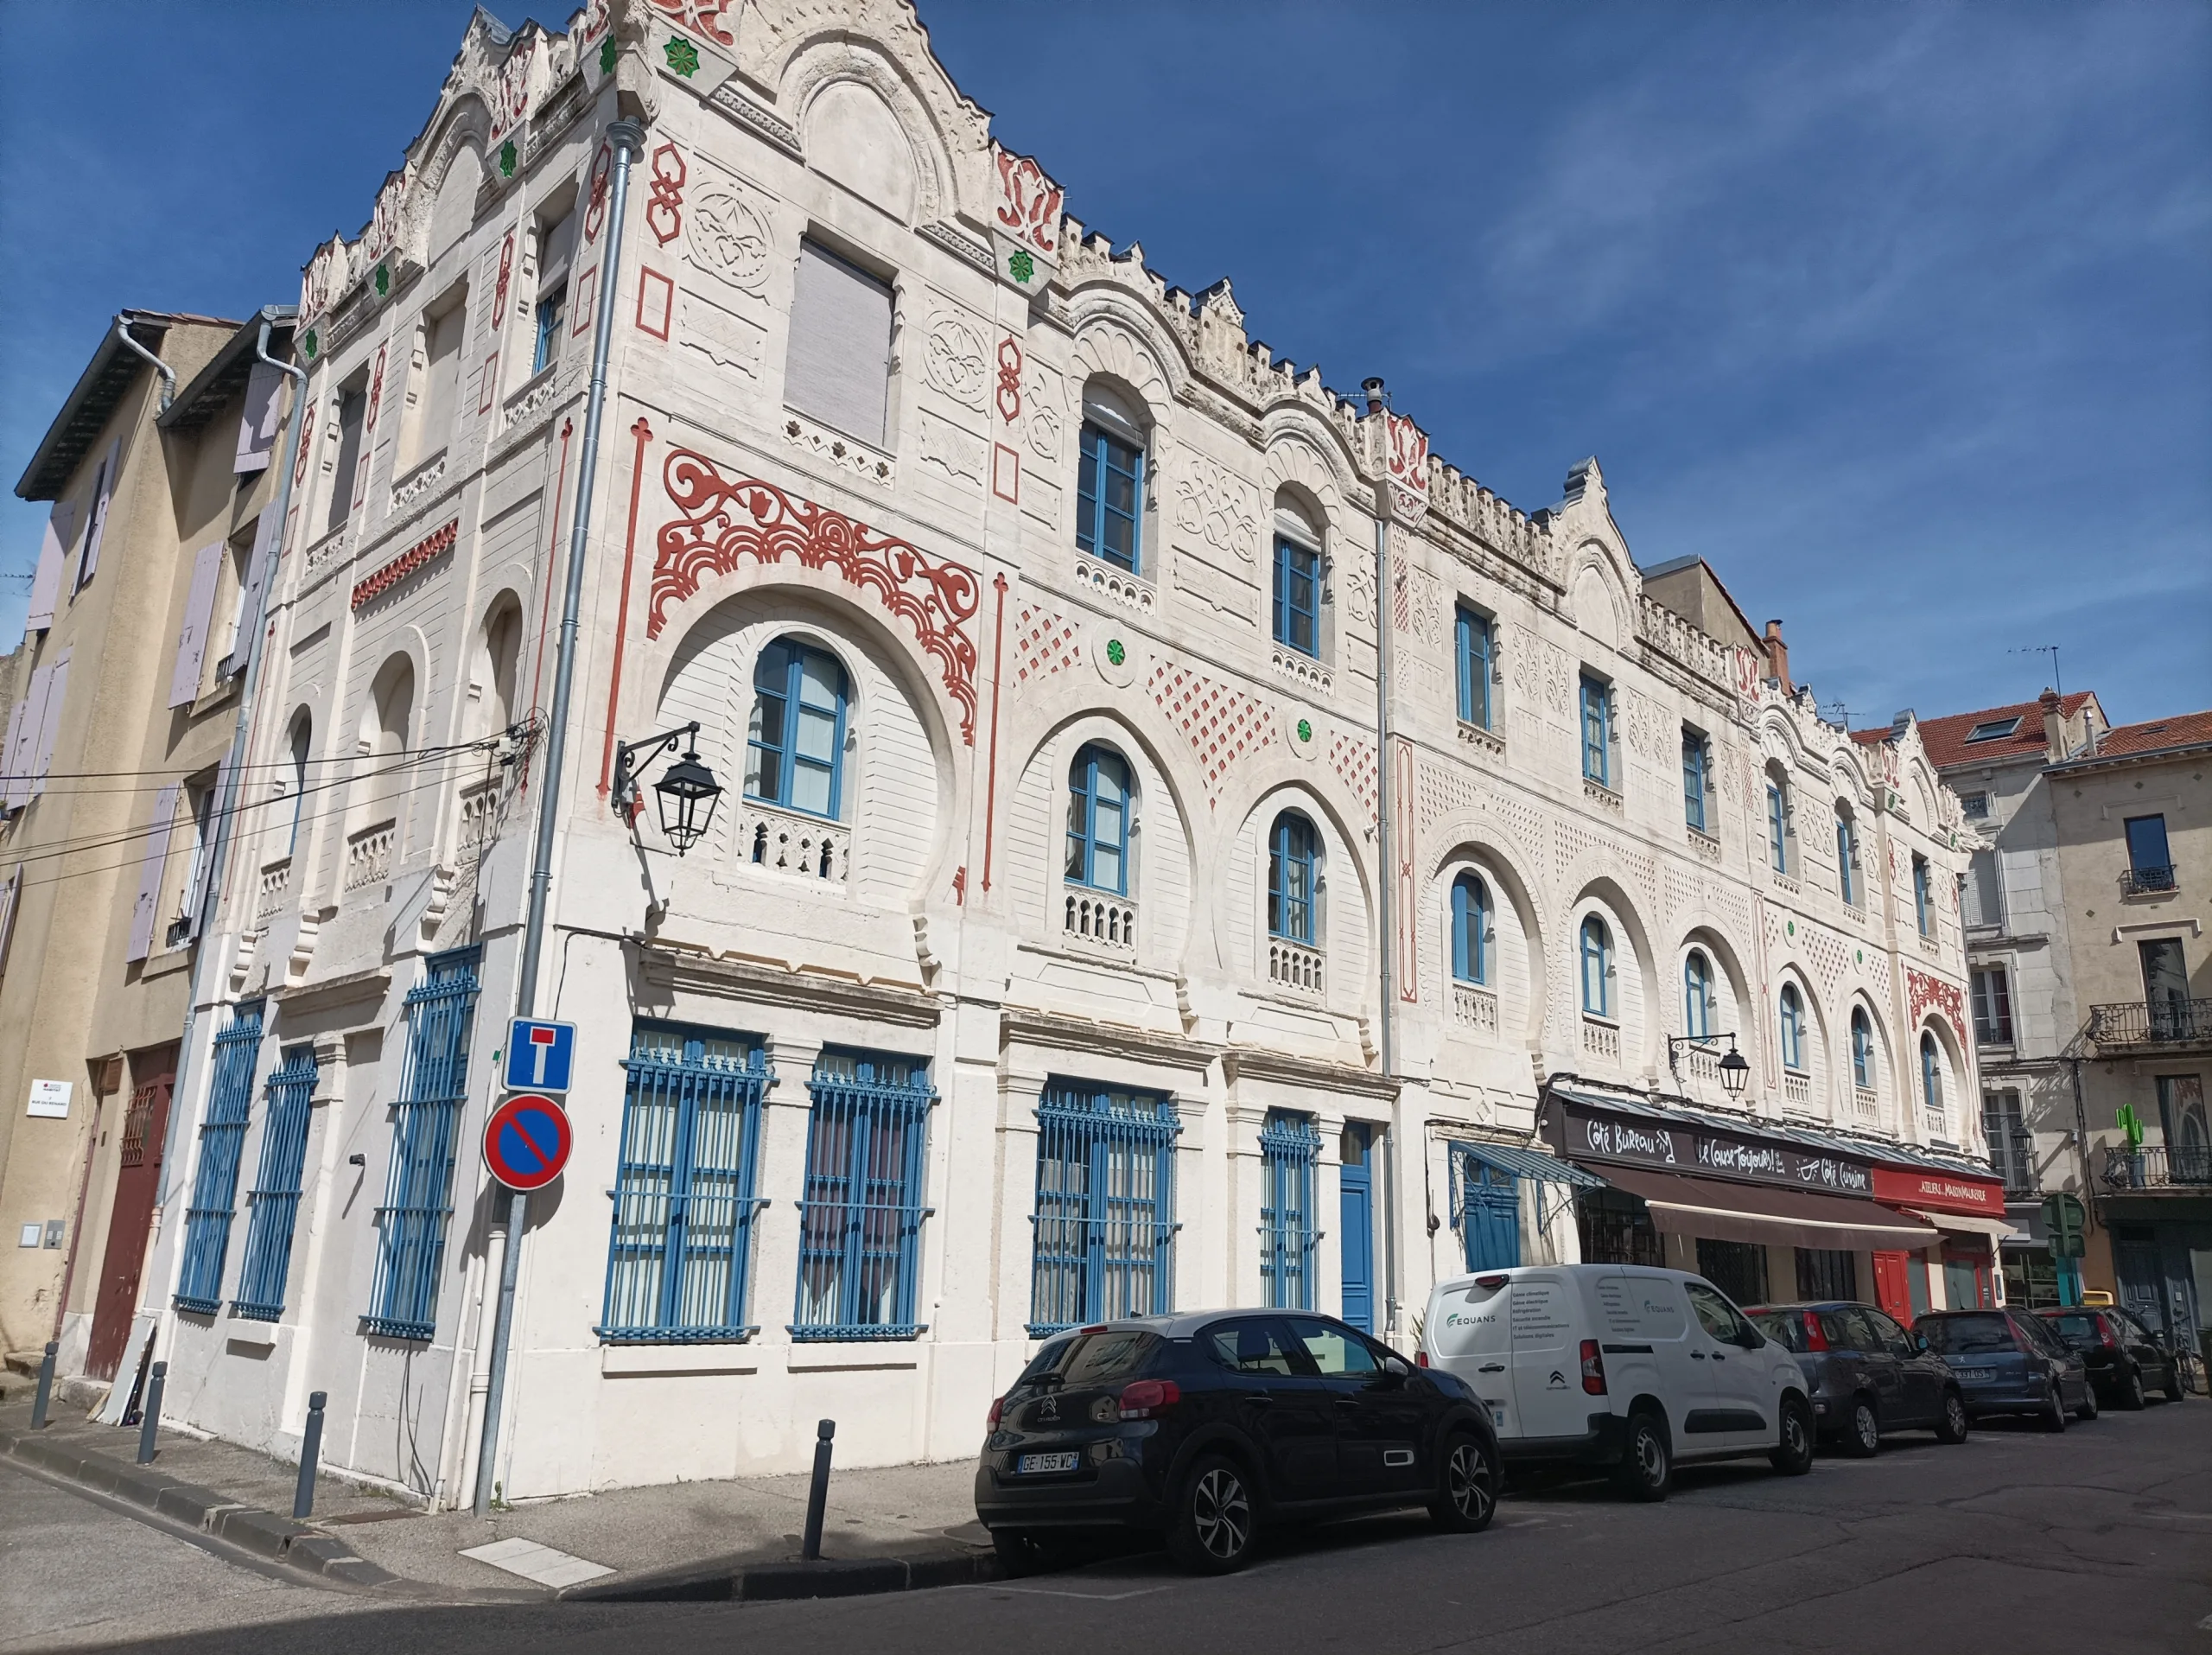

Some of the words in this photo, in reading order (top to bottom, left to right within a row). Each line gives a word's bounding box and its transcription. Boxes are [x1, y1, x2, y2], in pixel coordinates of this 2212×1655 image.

[1587, 1118, 1610, 1154] Côté
[1821, 1158, 1837, 1187] Côté
[1840, 1162, 1866, 1190] Cuisine
[1457, 1314, 1497, 1326] EQUANS
[1650, 1305, 1675, 1314] EQUANS
